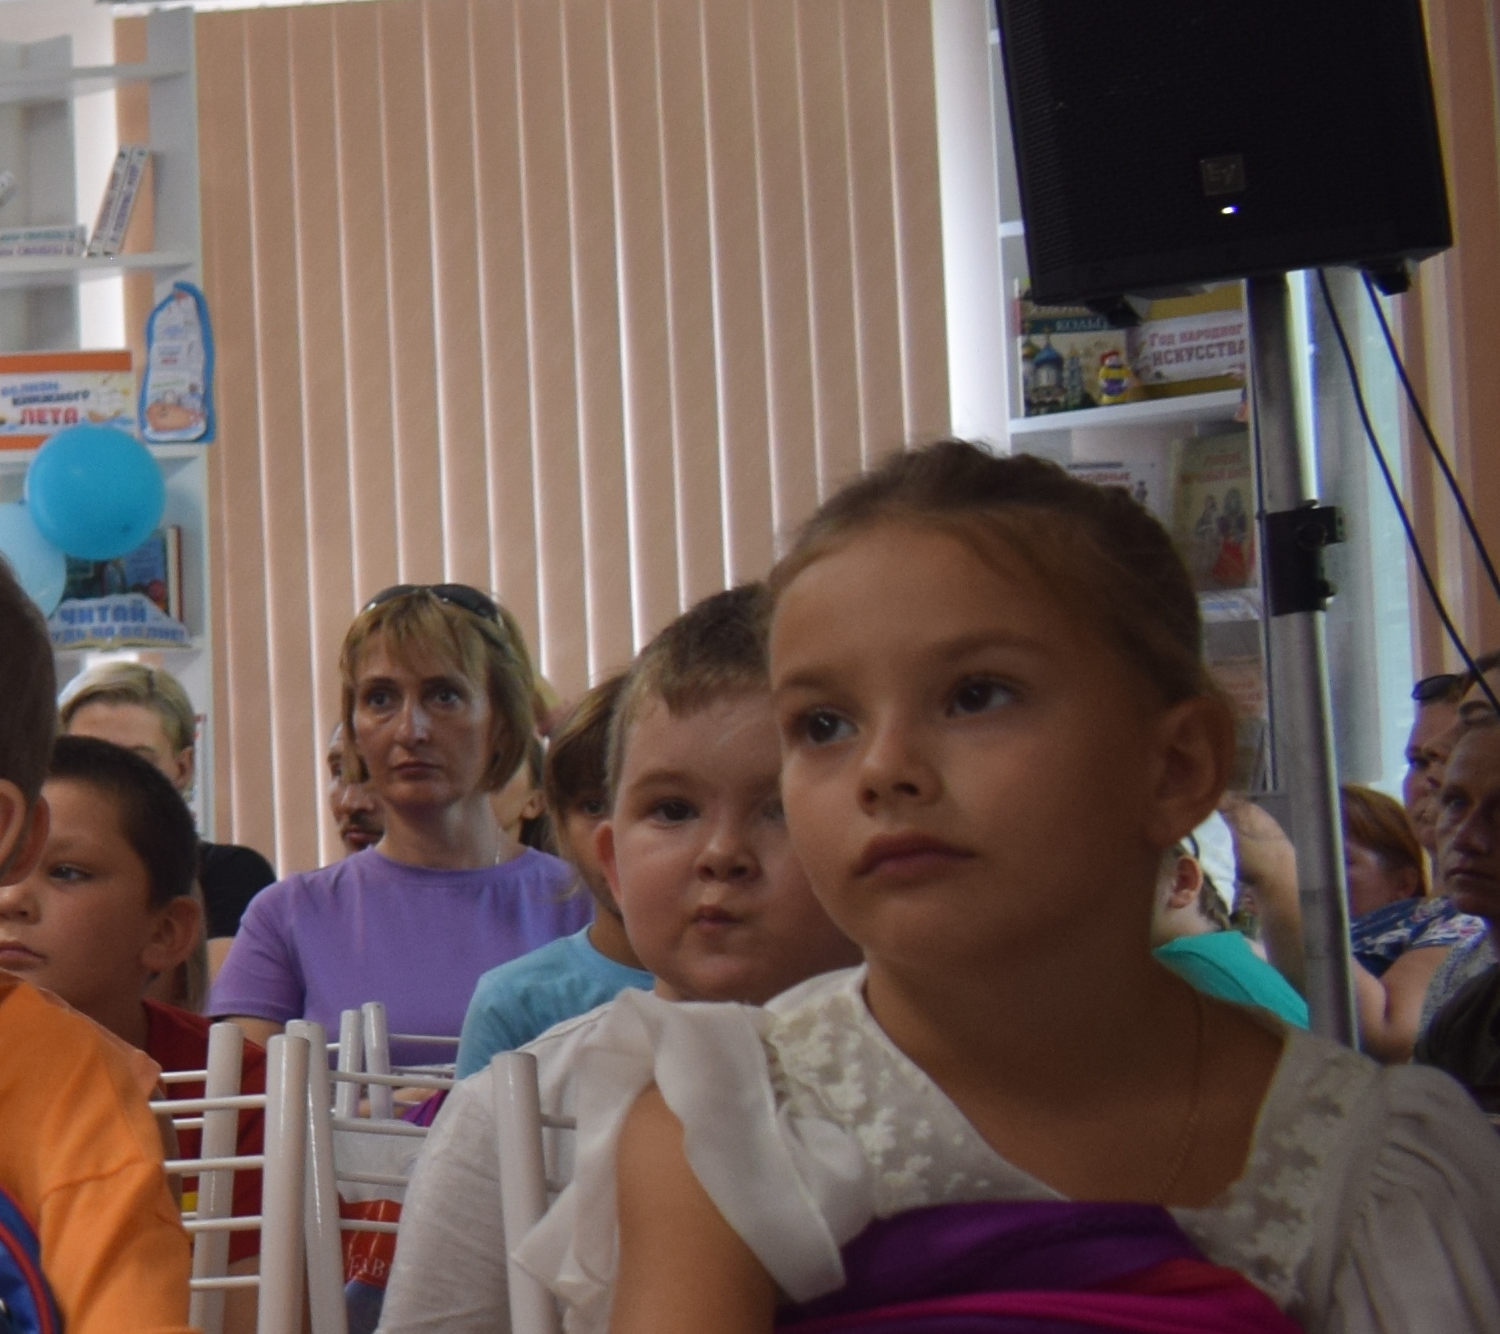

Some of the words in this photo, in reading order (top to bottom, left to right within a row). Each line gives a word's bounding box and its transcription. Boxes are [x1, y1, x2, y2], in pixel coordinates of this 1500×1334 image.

[1056, 317, 1108, 331] КОЛЬЦ
[20, 407, 79, 425] ЛЕТА
[51, 628, 84, 644] УДЬ
